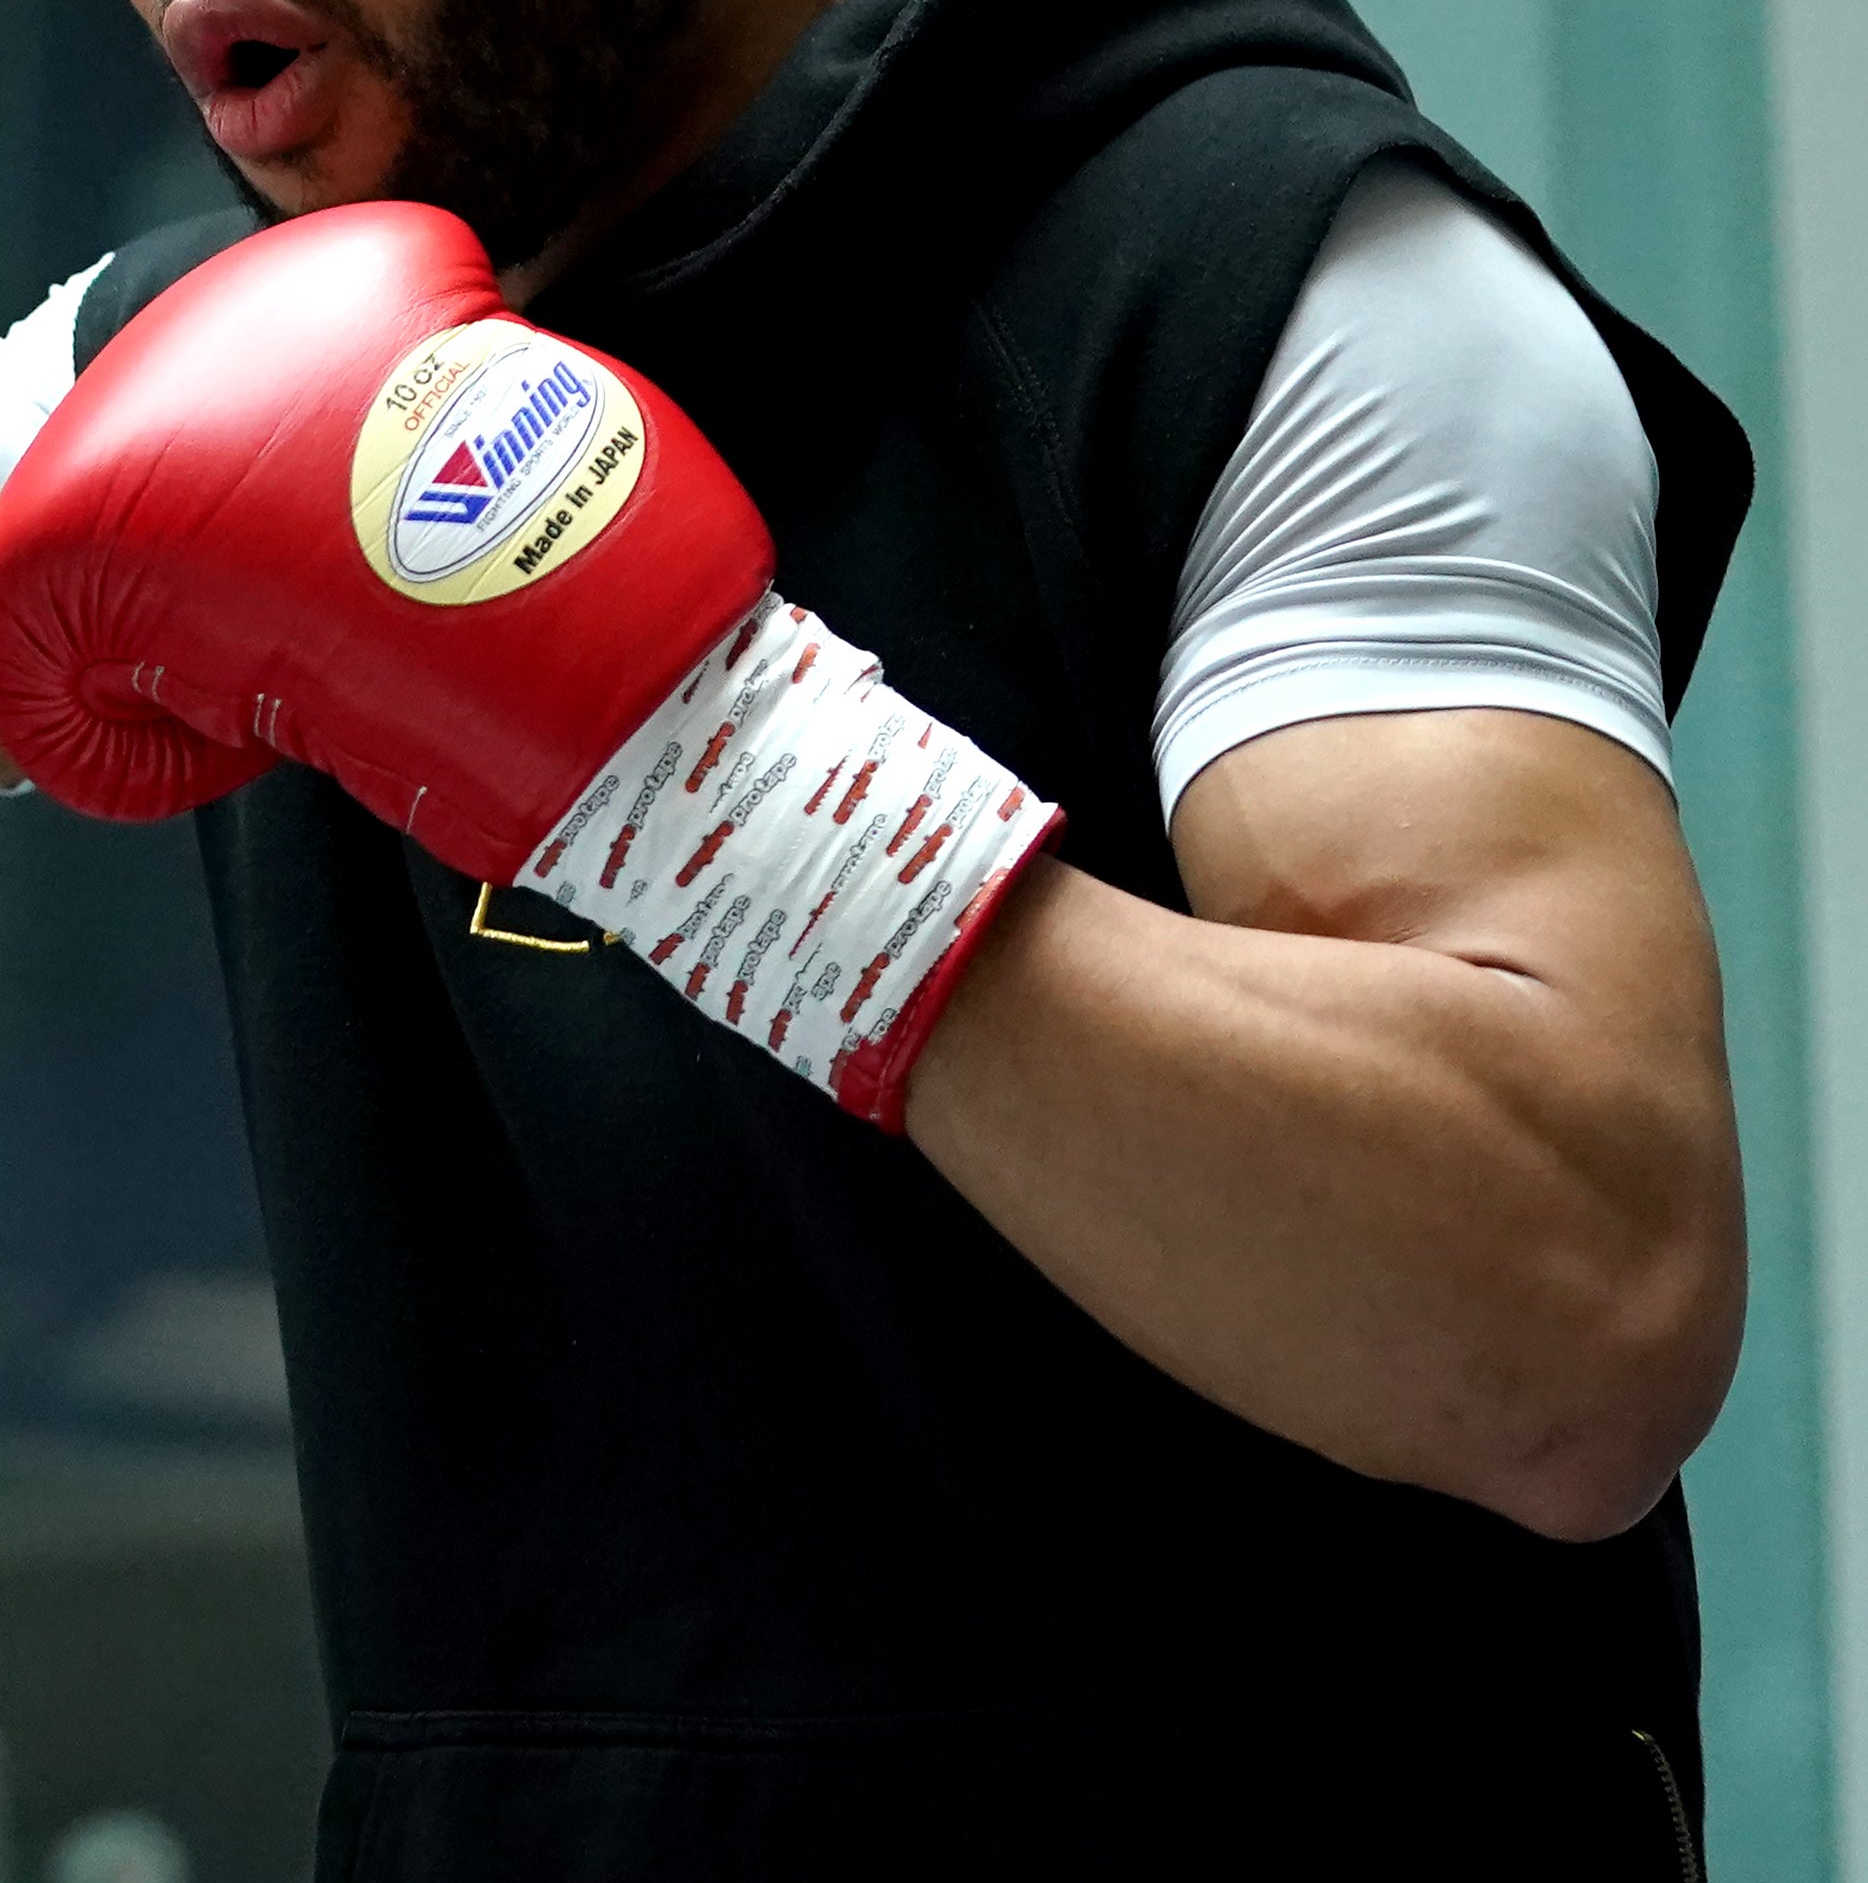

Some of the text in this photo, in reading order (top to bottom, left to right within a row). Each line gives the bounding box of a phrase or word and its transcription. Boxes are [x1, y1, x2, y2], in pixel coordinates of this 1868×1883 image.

[385, 383, 417, 413] 10
[403, 360, 592, 525] Winning
[404, 360, 470, 432] OFFICIAL
[476, 478, 522, 534] FIGHTING
[520, 438, 554, 477] SPORTS
[513, 425, 639, 576] Made in JAPAN
